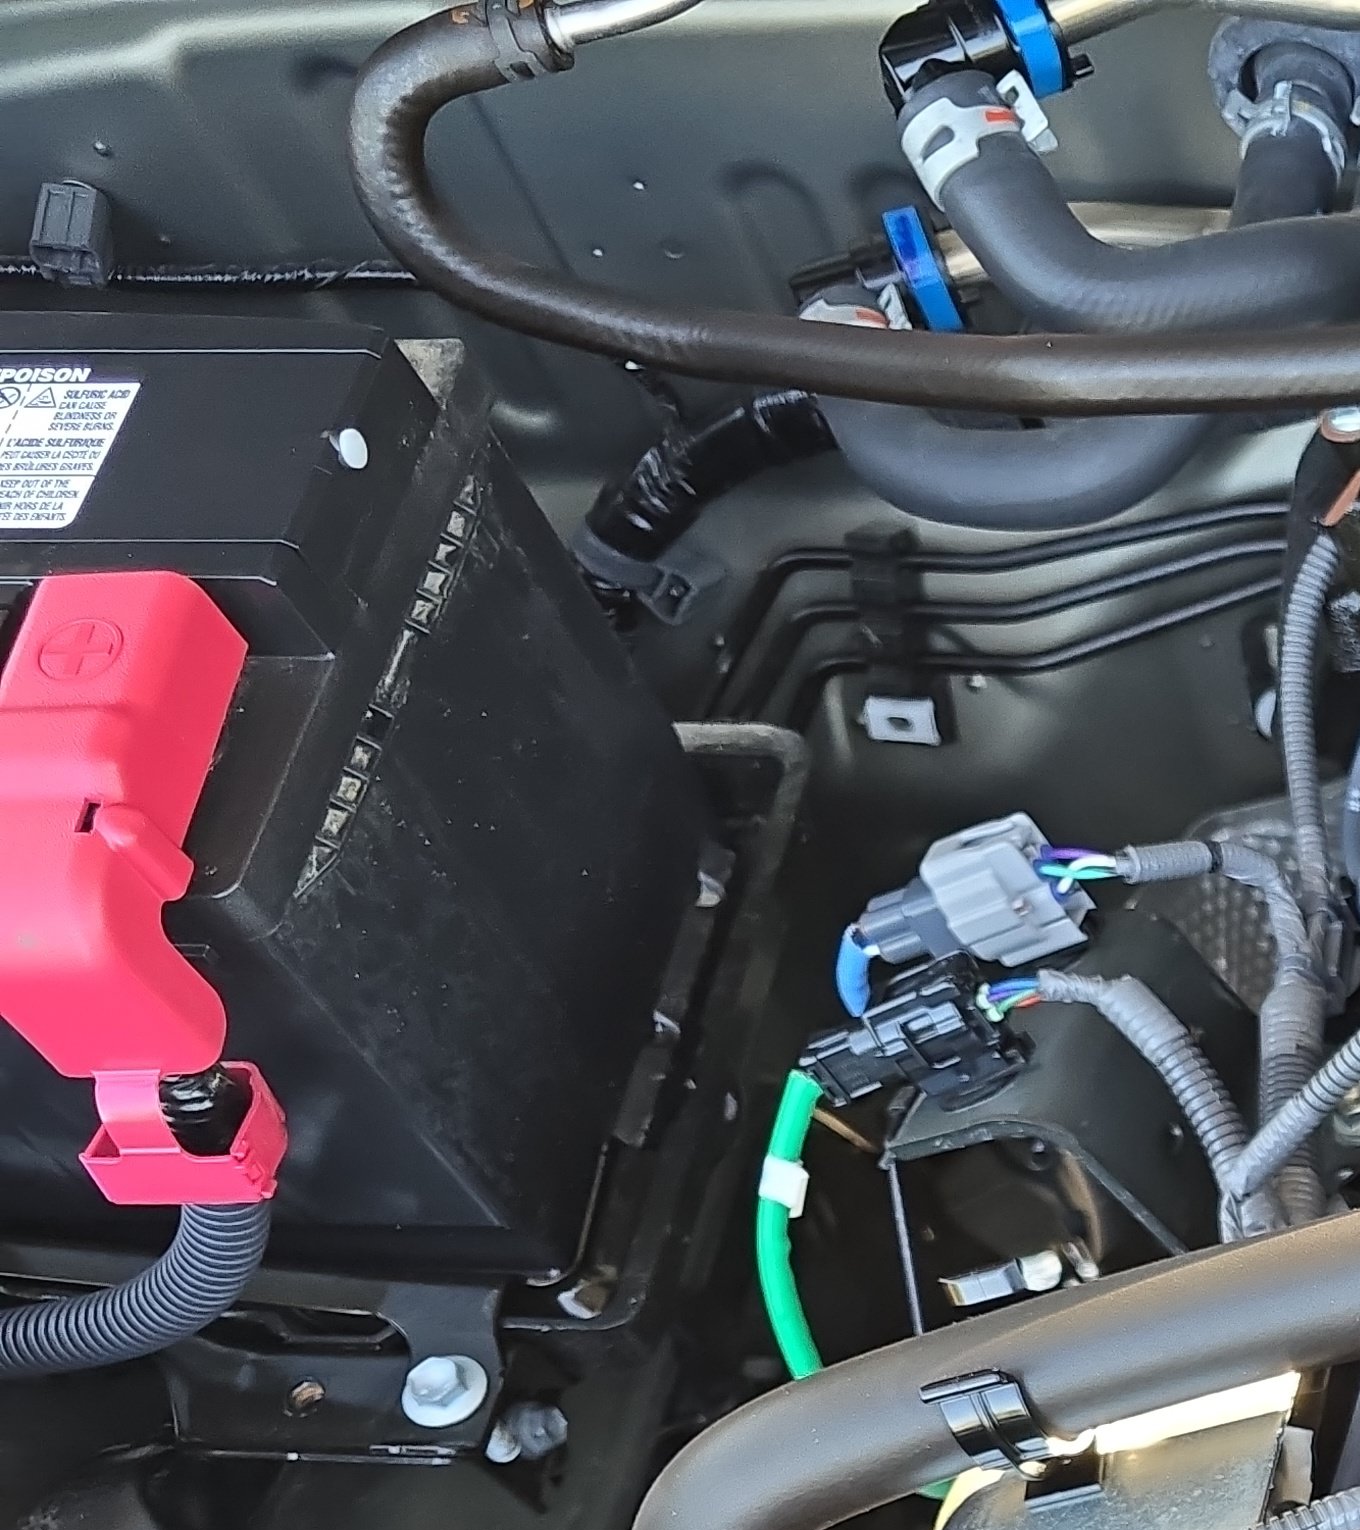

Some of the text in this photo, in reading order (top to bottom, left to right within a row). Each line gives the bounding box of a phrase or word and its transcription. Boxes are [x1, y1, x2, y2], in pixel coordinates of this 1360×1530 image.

[1, 367, 92, 382] POISON
[64, 389, 131, 399] SULFURIC ACID
[58, 401, 107, 409] CAN CAUSE
